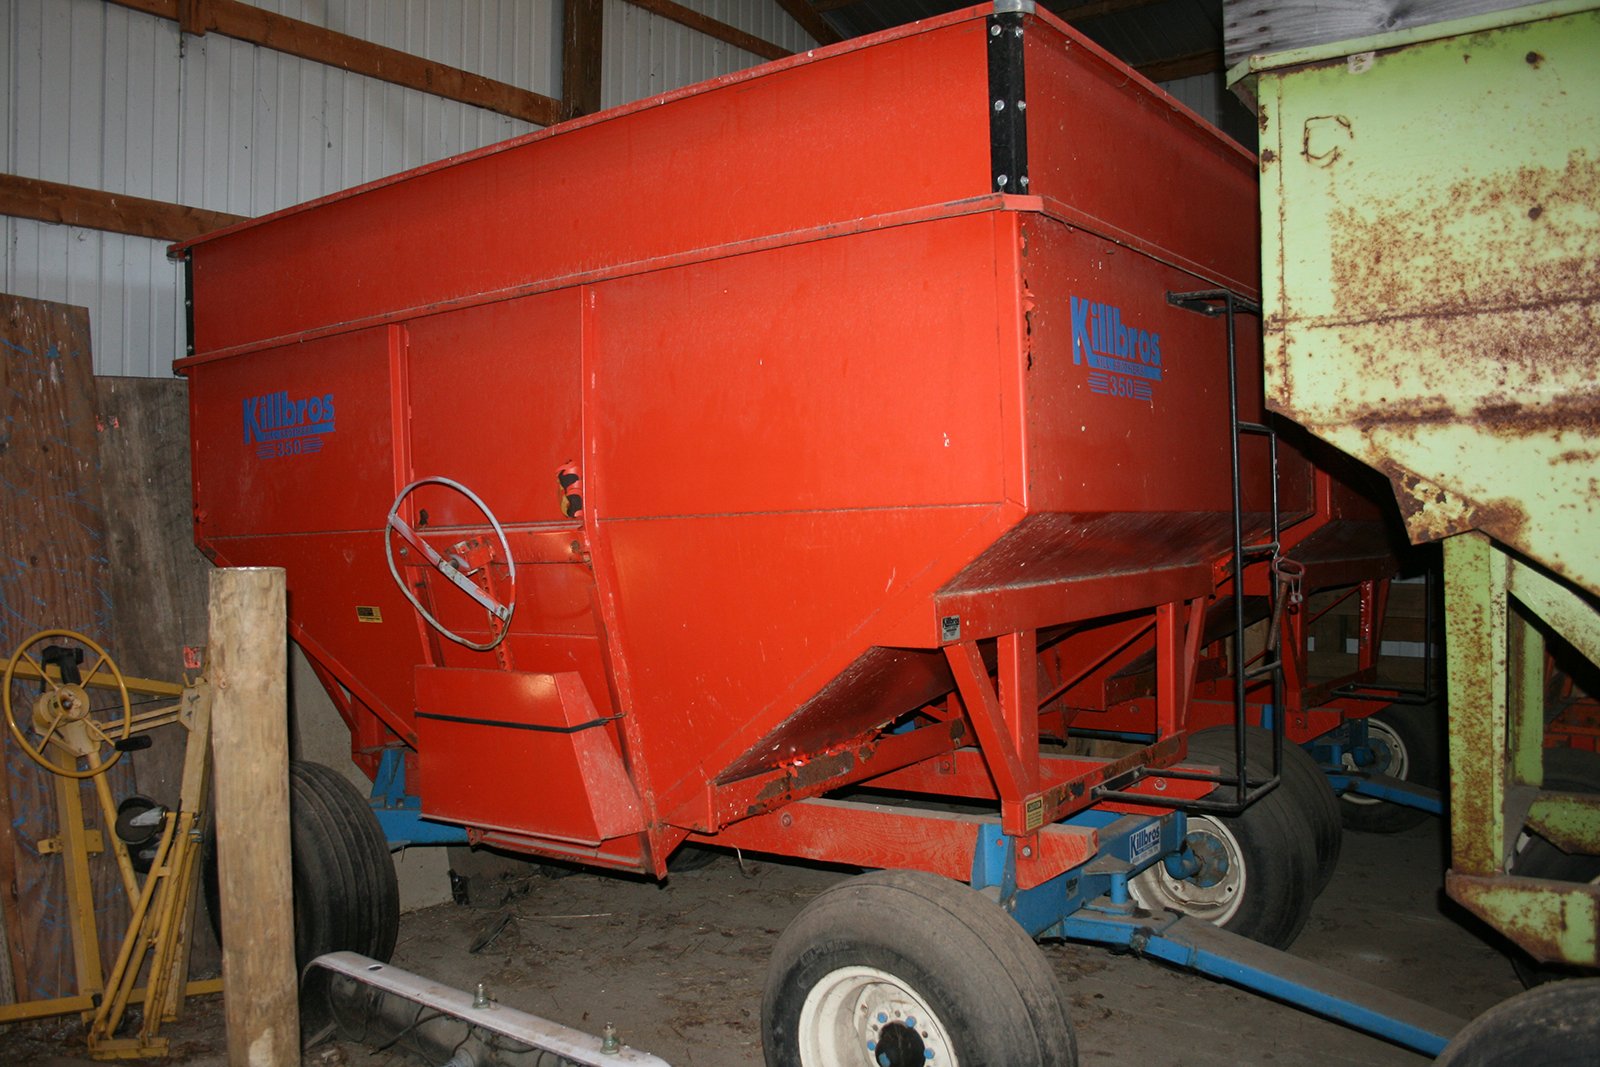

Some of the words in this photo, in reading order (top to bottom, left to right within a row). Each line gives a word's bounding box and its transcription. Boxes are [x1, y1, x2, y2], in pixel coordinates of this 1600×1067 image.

[1070, 295, 1161, 366] Killbros
[1110, 375, 1135, 398] 350
[243, 391, 335, 445] Killbros
[277, 439, 302, 457] 350
[1130, 826, 1160, 859] Killbros
